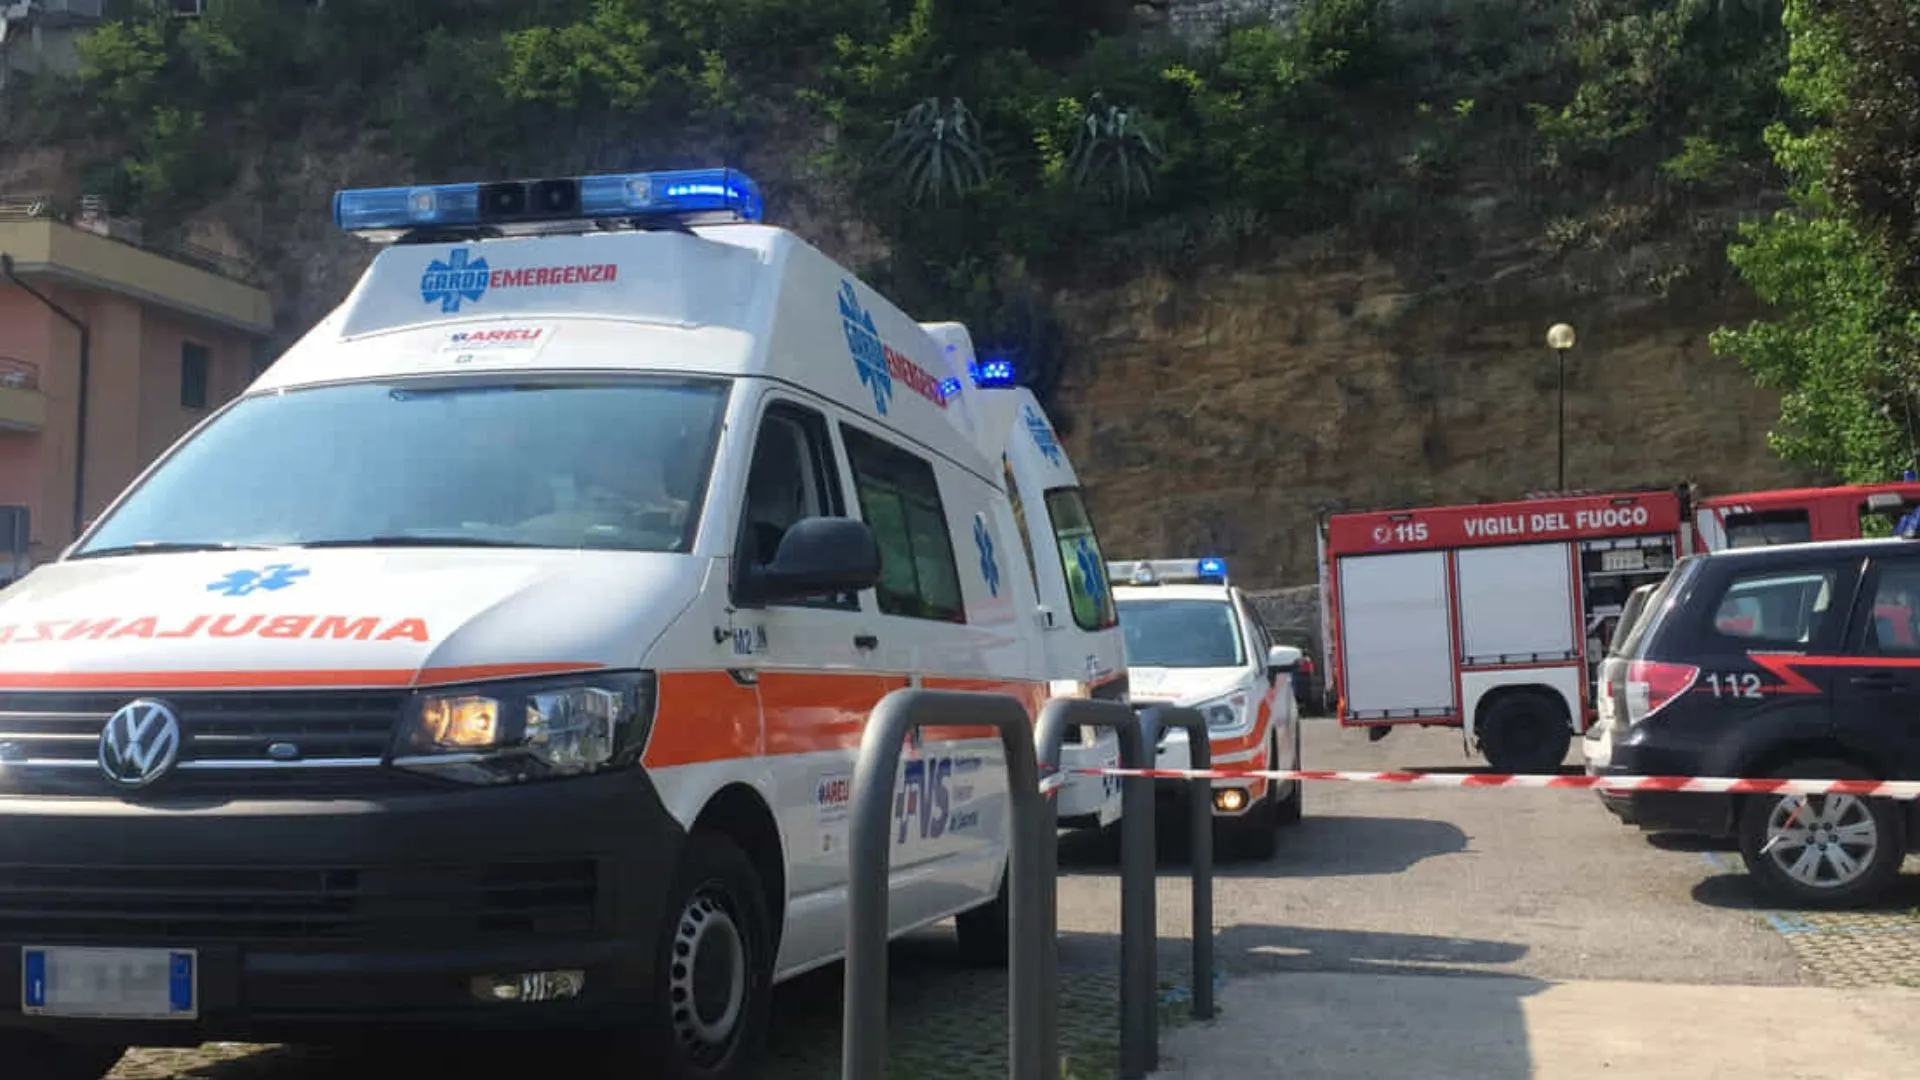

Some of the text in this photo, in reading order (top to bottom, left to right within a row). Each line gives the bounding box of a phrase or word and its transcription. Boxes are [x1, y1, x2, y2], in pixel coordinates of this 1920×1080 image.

[489, 263, 617, 289] EMERGENZA
[1394, 522, 1428, 543] 115
[1463, 506, 1648, 538] VIGILI DEL FUOCO
[1705, 672, 1764, 698] 112
